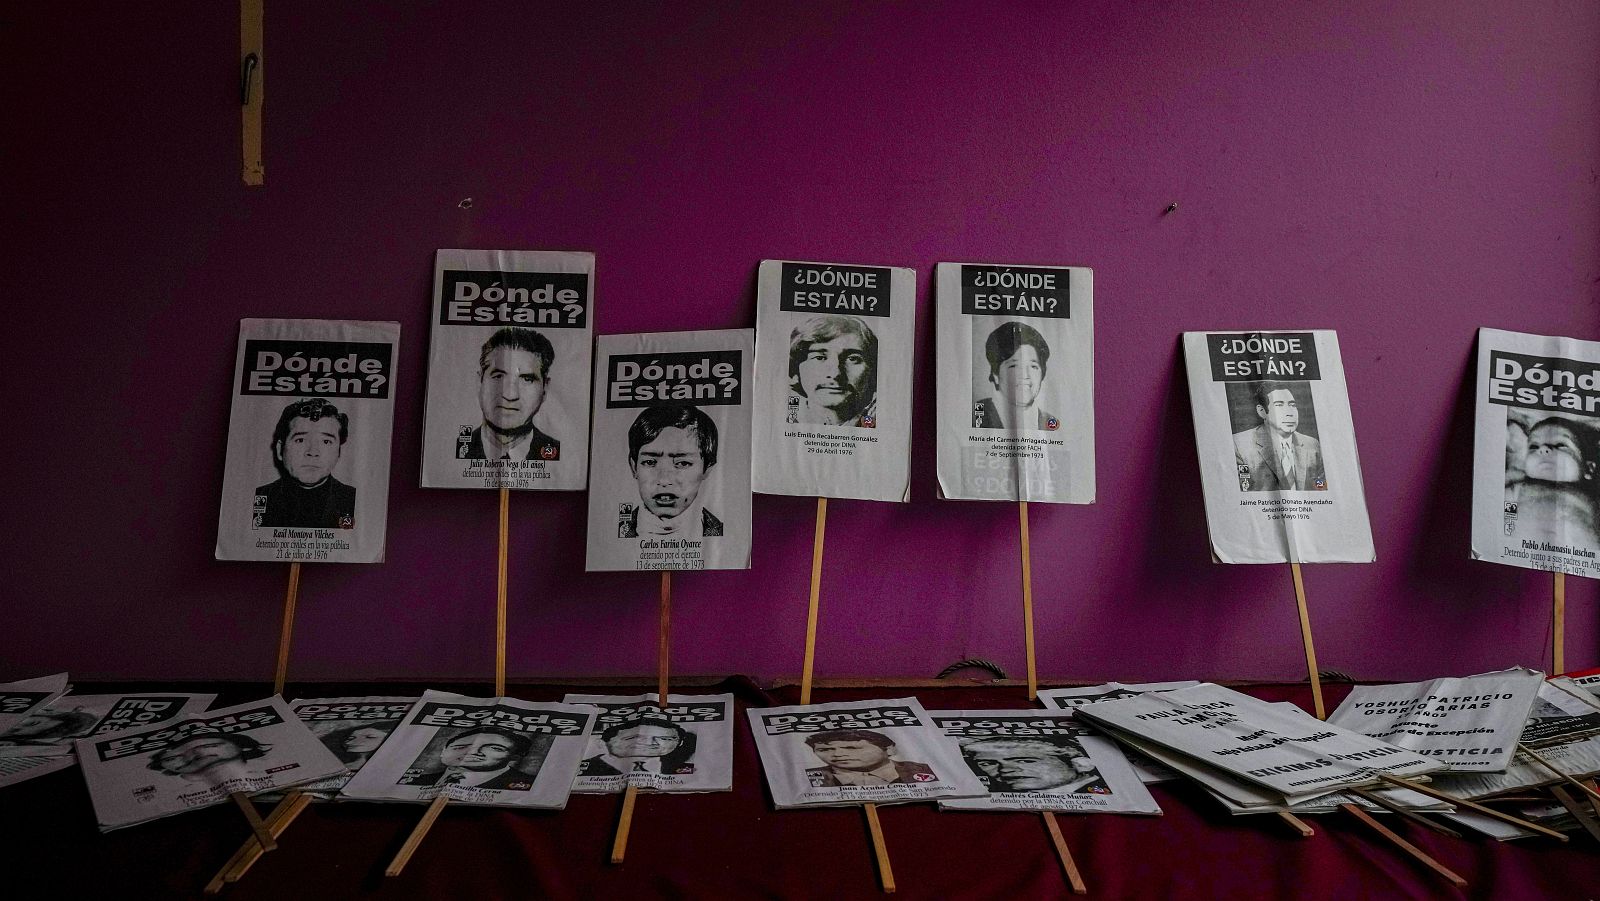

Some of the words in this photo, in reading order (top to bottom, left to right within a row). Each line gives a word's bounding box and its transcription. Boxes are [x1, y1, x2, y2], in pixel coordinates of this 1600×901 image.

[794, 267, 876, 288] ¿DÓNDE
[974, 269, 1055, 289] ¿DÓNDE
[454, 281, 579, 304] Dónde
[794, 290, 877, 311] ESTÁN?
[975, 292, 1057, 313] ESTÁN?
[448, 301, 584, 323] Están?
[1221, 334, 1302, 354] ¿DÓNDE
[256, 351, 382, 374] Dónde
[1223, 356, 1306, 375] ESTÁN?
[617, 359, 734, 381] Dónde
[248, 371, 387, 394] Están?
[611, 378, 738, 401] Están?
[817, 433, 849, 441] Recabarren
[484, 459, 504, 468] Roberto
[506, 460, 518, 471] Vega
[463, 468, 484, 478] detenido
[486, 471, 494, 479] por
[518, 469, 523, 478] la
[491, 479, 498, 488] de
[516, 479, 529, 488] 1976
[273, 528, 286, 538] Raúl
[288, 529, 312, 541] Montoya
[314, 529, 334, 539] Vilches
[256, 538, 279, 548] detenido
[280, 542, 290, 551] por
[290, 539, 306, 548] civiles
[316, 540, 321, 549] la
[640, 539, 658, 549] Carlos
[660, 538, 679, 549] Fariña
[681, 538, 701, 551] Oyarce
[1522, 539, 1538, 550] Pablo
[1540, 542, 1571, 554] Athanasiu
[276, 550, 283, 559] 21
[284, 550, 291, 559] de
[306, 550, 312, 559] de
[314, 550, 328, 560] 1976
[640, 550, 663, 559] detenido
[665, 552, 674, 561] por
[675, 549, 679, 559] el
[1504, 546, 1529, 558] Detenido
[1530, 551, 1545, 562] junto
[1563, 557, 1580, 567] padres
[644, 560, 650, 569] de
[651, 560, 680, 570] septiembre
[683, 560, 689, 569] de
[691, 560, 704, 569] 1973
[1540, 562, 1547, 570] de
[1354, 698, 1420, 709] YOSHUA
[1427, 693, 1513, 703] PATRICIO
[1136, 709, 1188, 720] PAULA
[1364, 703, 1427, 716] OSORIO
[1435, 702, 1490, 711] ARIAS
[1414, 710, 1448, 718] AÑOS
[434, 707, 577, 726] Dónde
[769, 709, 909, 725] Dónde
[109, 712, 267, 747] Dónde
[421, 714, 580, 734] Están?
[1391, 721, 1439, 729] Muerto
[1426, 727, 1494, 737] Excepción
[1413, 748, 1503, 756] USTICIA
[1247, 758, 1333, 778] EXIGIMOS
[621, 773, 651, 781] Canteros
[210, 778, 242, 791] Barrios
[449, 784, 477, 792] Castillo
